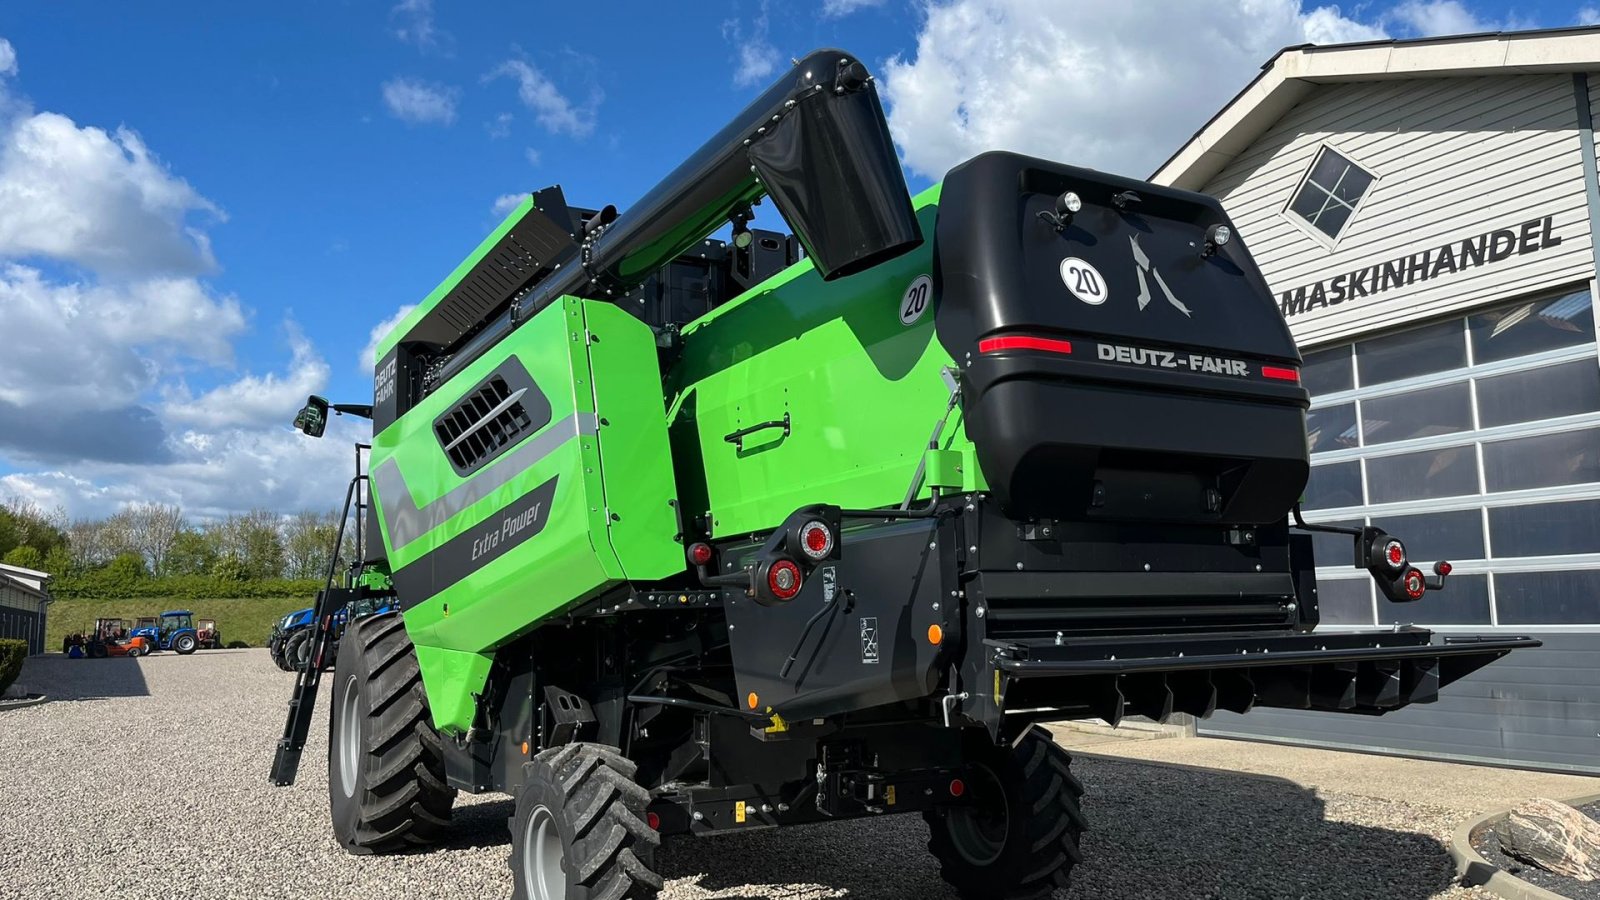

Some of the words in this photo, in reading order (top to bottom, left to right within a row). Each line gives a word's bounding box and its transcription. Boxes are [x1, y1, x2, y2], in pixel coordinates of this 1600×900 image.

[1070, 266, 1101, 296] 20
[1281, 216, 1562, 318] MASKINHANDEL
[904, 283, 927, 318] 20
[375, 357, 397, 391] DEUTZ
[1097, 343, 1250, 377] DEUTZ-FAHR
[375, 379, 394, 408] FAHR
[471, 529, 500, 561] Extra
[501, 502, 541, 542] Power
